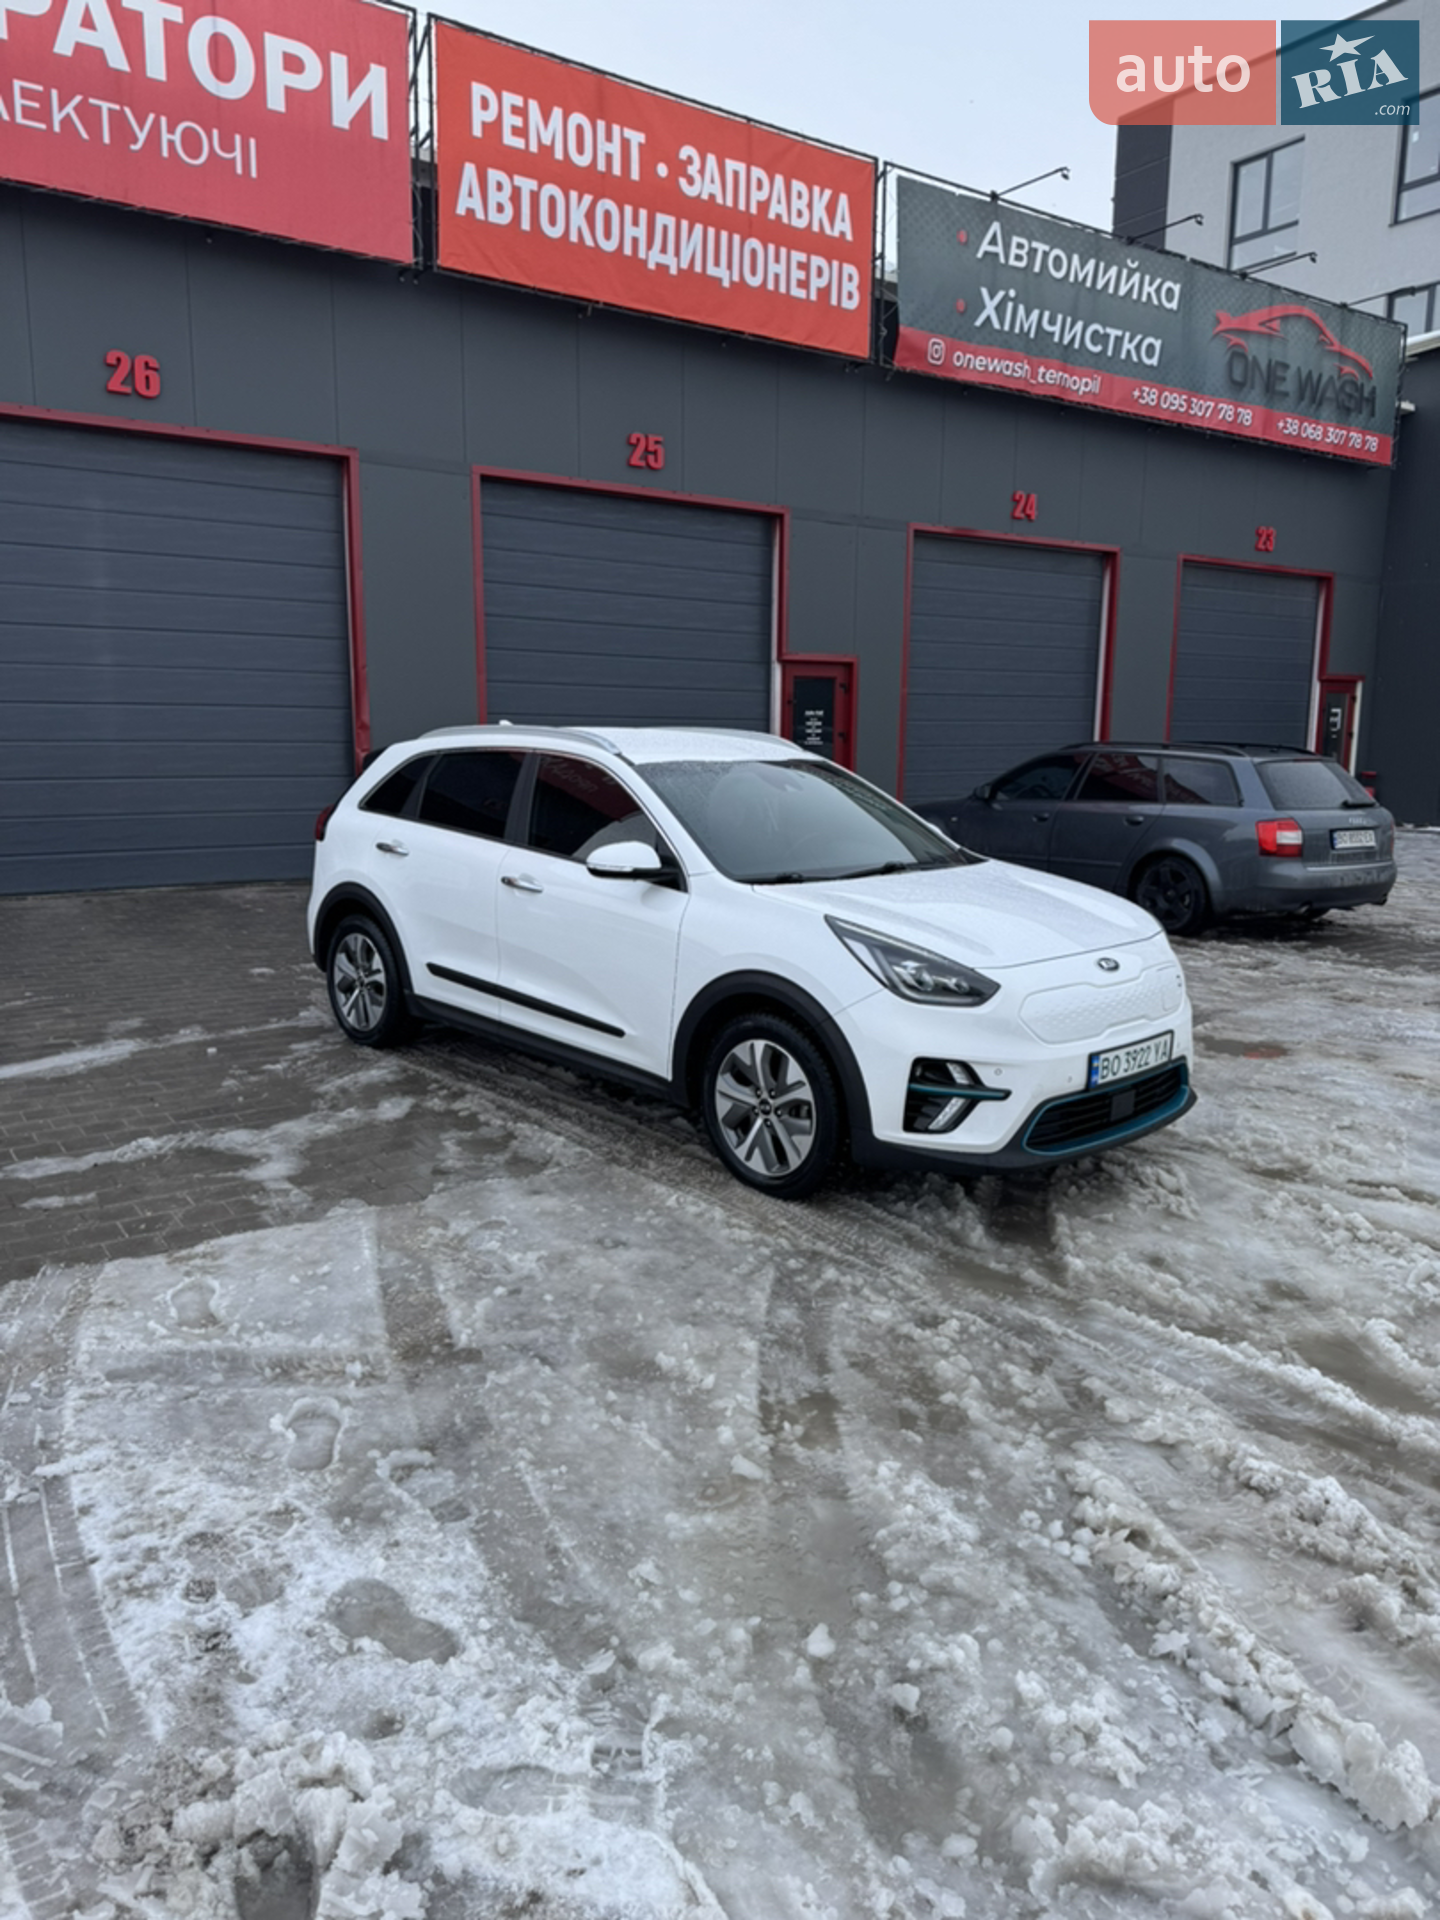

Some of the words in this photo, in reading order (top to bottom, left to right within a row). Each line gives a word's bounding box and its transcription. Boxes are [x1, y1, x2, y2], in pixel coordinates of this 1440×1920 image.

[0, 79, 258, 179] ЕКТУЮЧІ
[470, 81, 646, 182] РЕМОНТ
[678, 144, 854, 242] ЗАПРАВКА
[455, 161, 860, 311] АВТОКОНДИЦІОНЕРІВ
[975, 220, 1182, 312] Автомийка
[974, 286, 1163, 367] Хімчистка
[104, 349, 160, 399] 26
[1227, 350, 1290, 399] ONE
[1296, 364, 1377, 418] WASH
[1132, 386, 1159, 406] +38
[1160, 391, 1188, 412] 095
[1189, 397, 1215, 418] 307
[1217, 403, 1235, 422] 78
[1237, 407, 1253, 426] 78
[627, 432, 665, 470] 25
[1276, 417, 1300, 436] +38
[1325, 426, 1347, 445] 307
[1347, 431, 1363, 449] 78
[1364, 434, 1379, 452] 78
[1010, 490, 1038, 522] 24
[1255, 525, 1277, 552] 23
[1101, 1054, 1121, 1080] BO
[1123, 1045, 1151, 1073] 3922
[1153, 1038, 1169, 1063] YA
